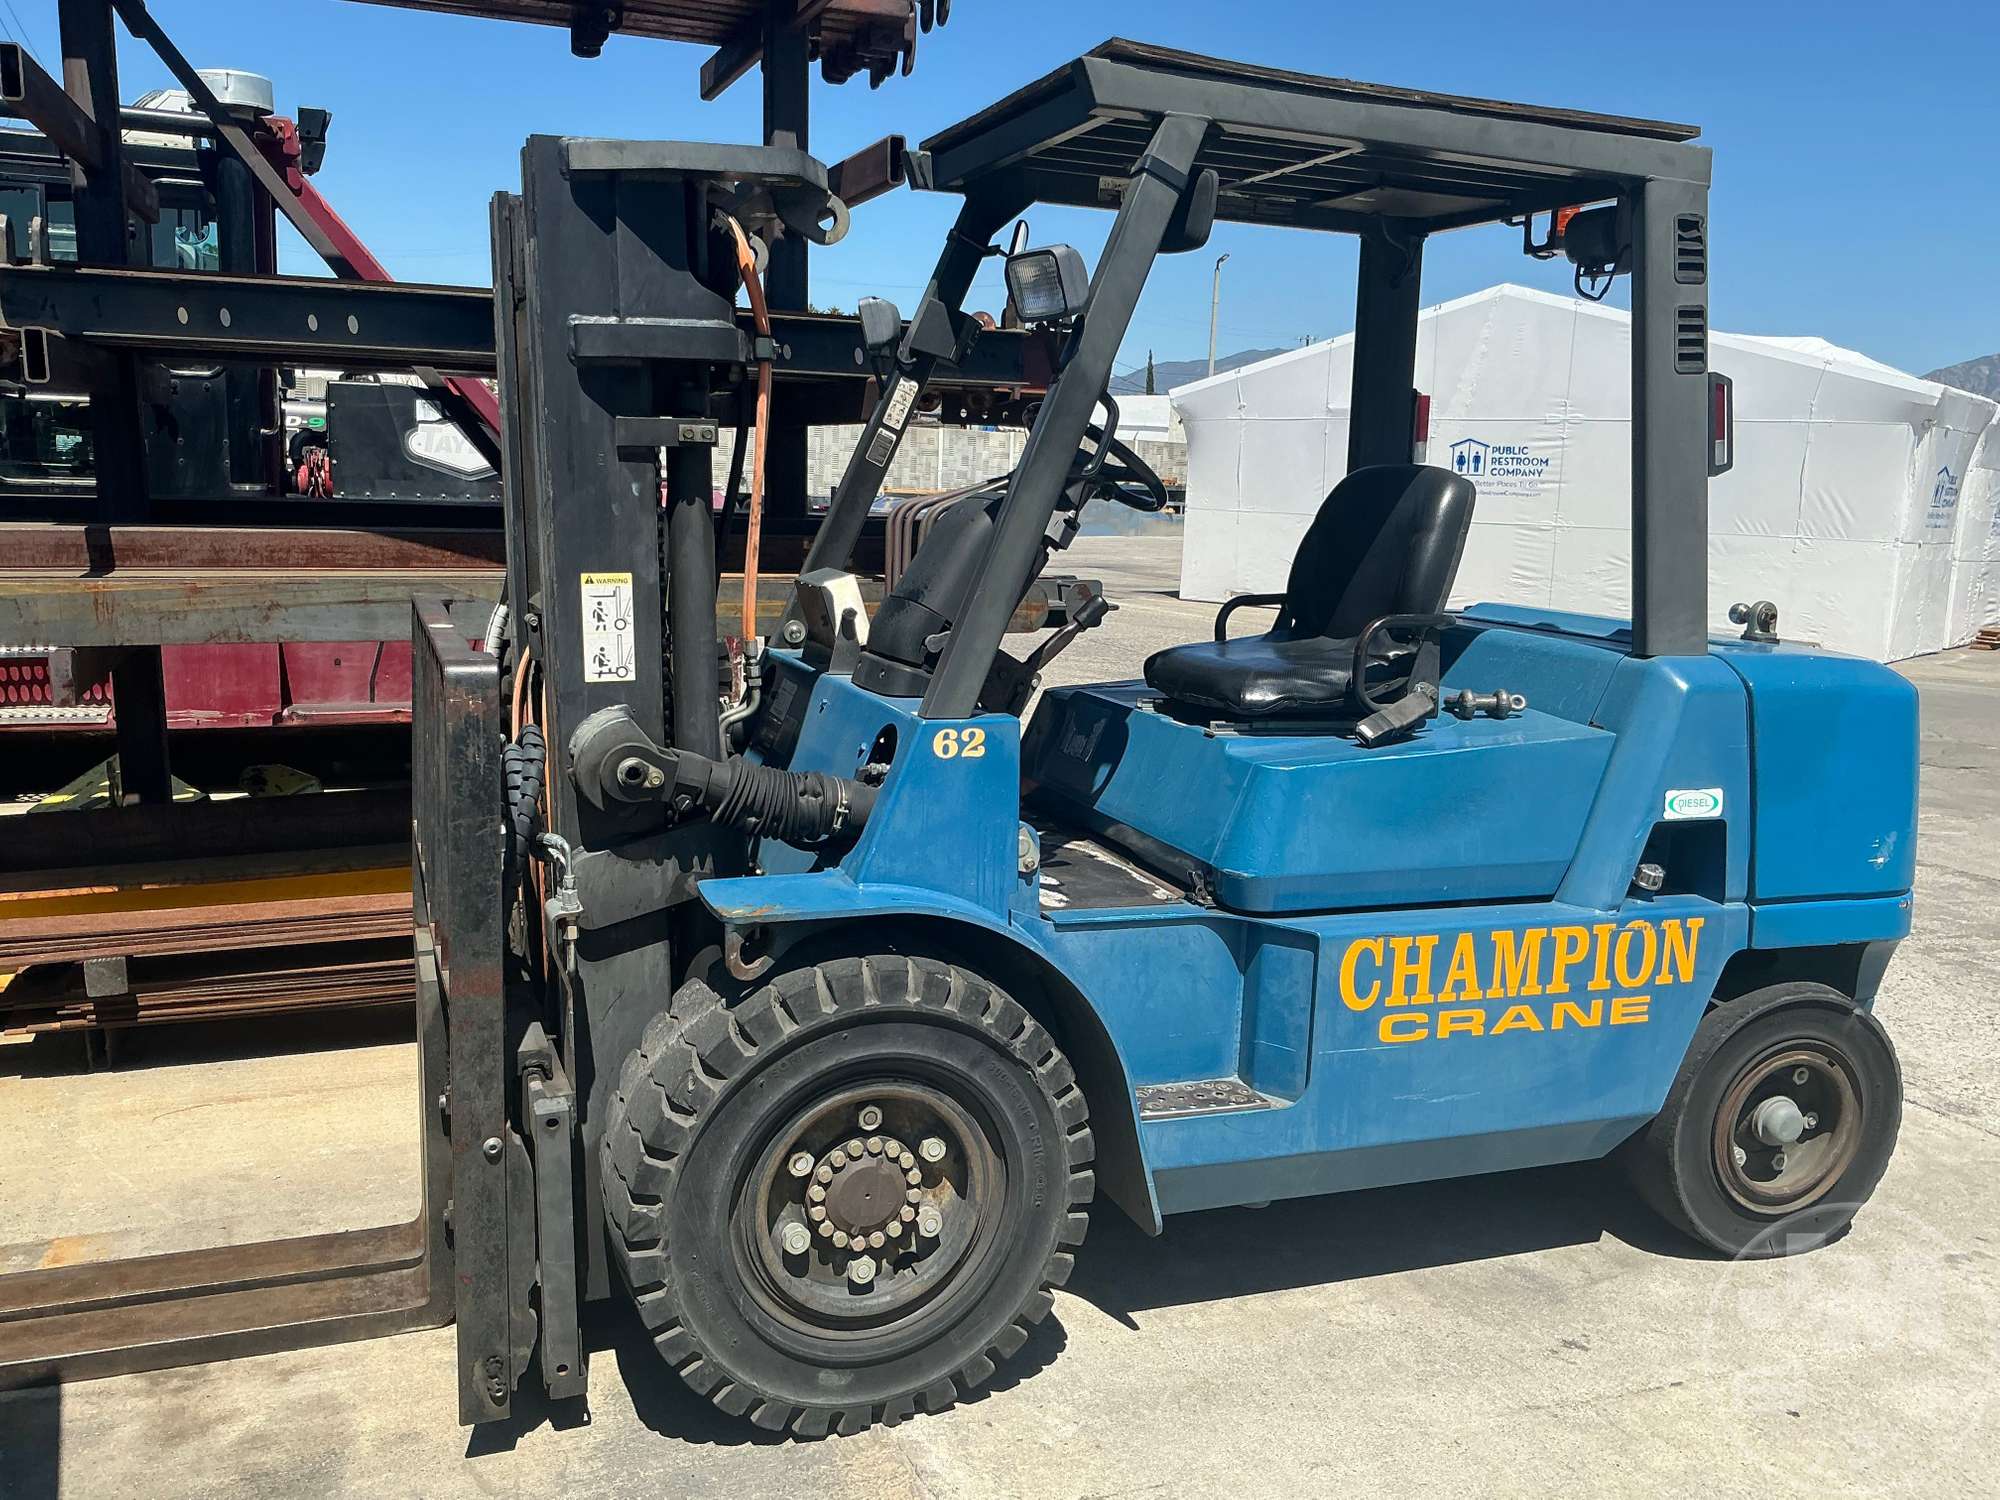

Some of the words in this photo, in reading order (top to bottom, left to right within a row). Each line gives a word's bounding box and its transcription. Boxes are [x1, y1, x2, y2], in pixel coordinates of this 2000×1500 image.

[1492, 446, 1529, 455] PUBLIC
[1491, 457, 1549, 466] RESTROOM
[1490, 468, 1543, 477] COMPANY
[933, 728, 986, 759] 62
[1678, 798, 1711, 809] DIESEL
[1339, 917, 1705, 1012] CHAMPION
[1378, 995, 1651, 1043] CRANE
